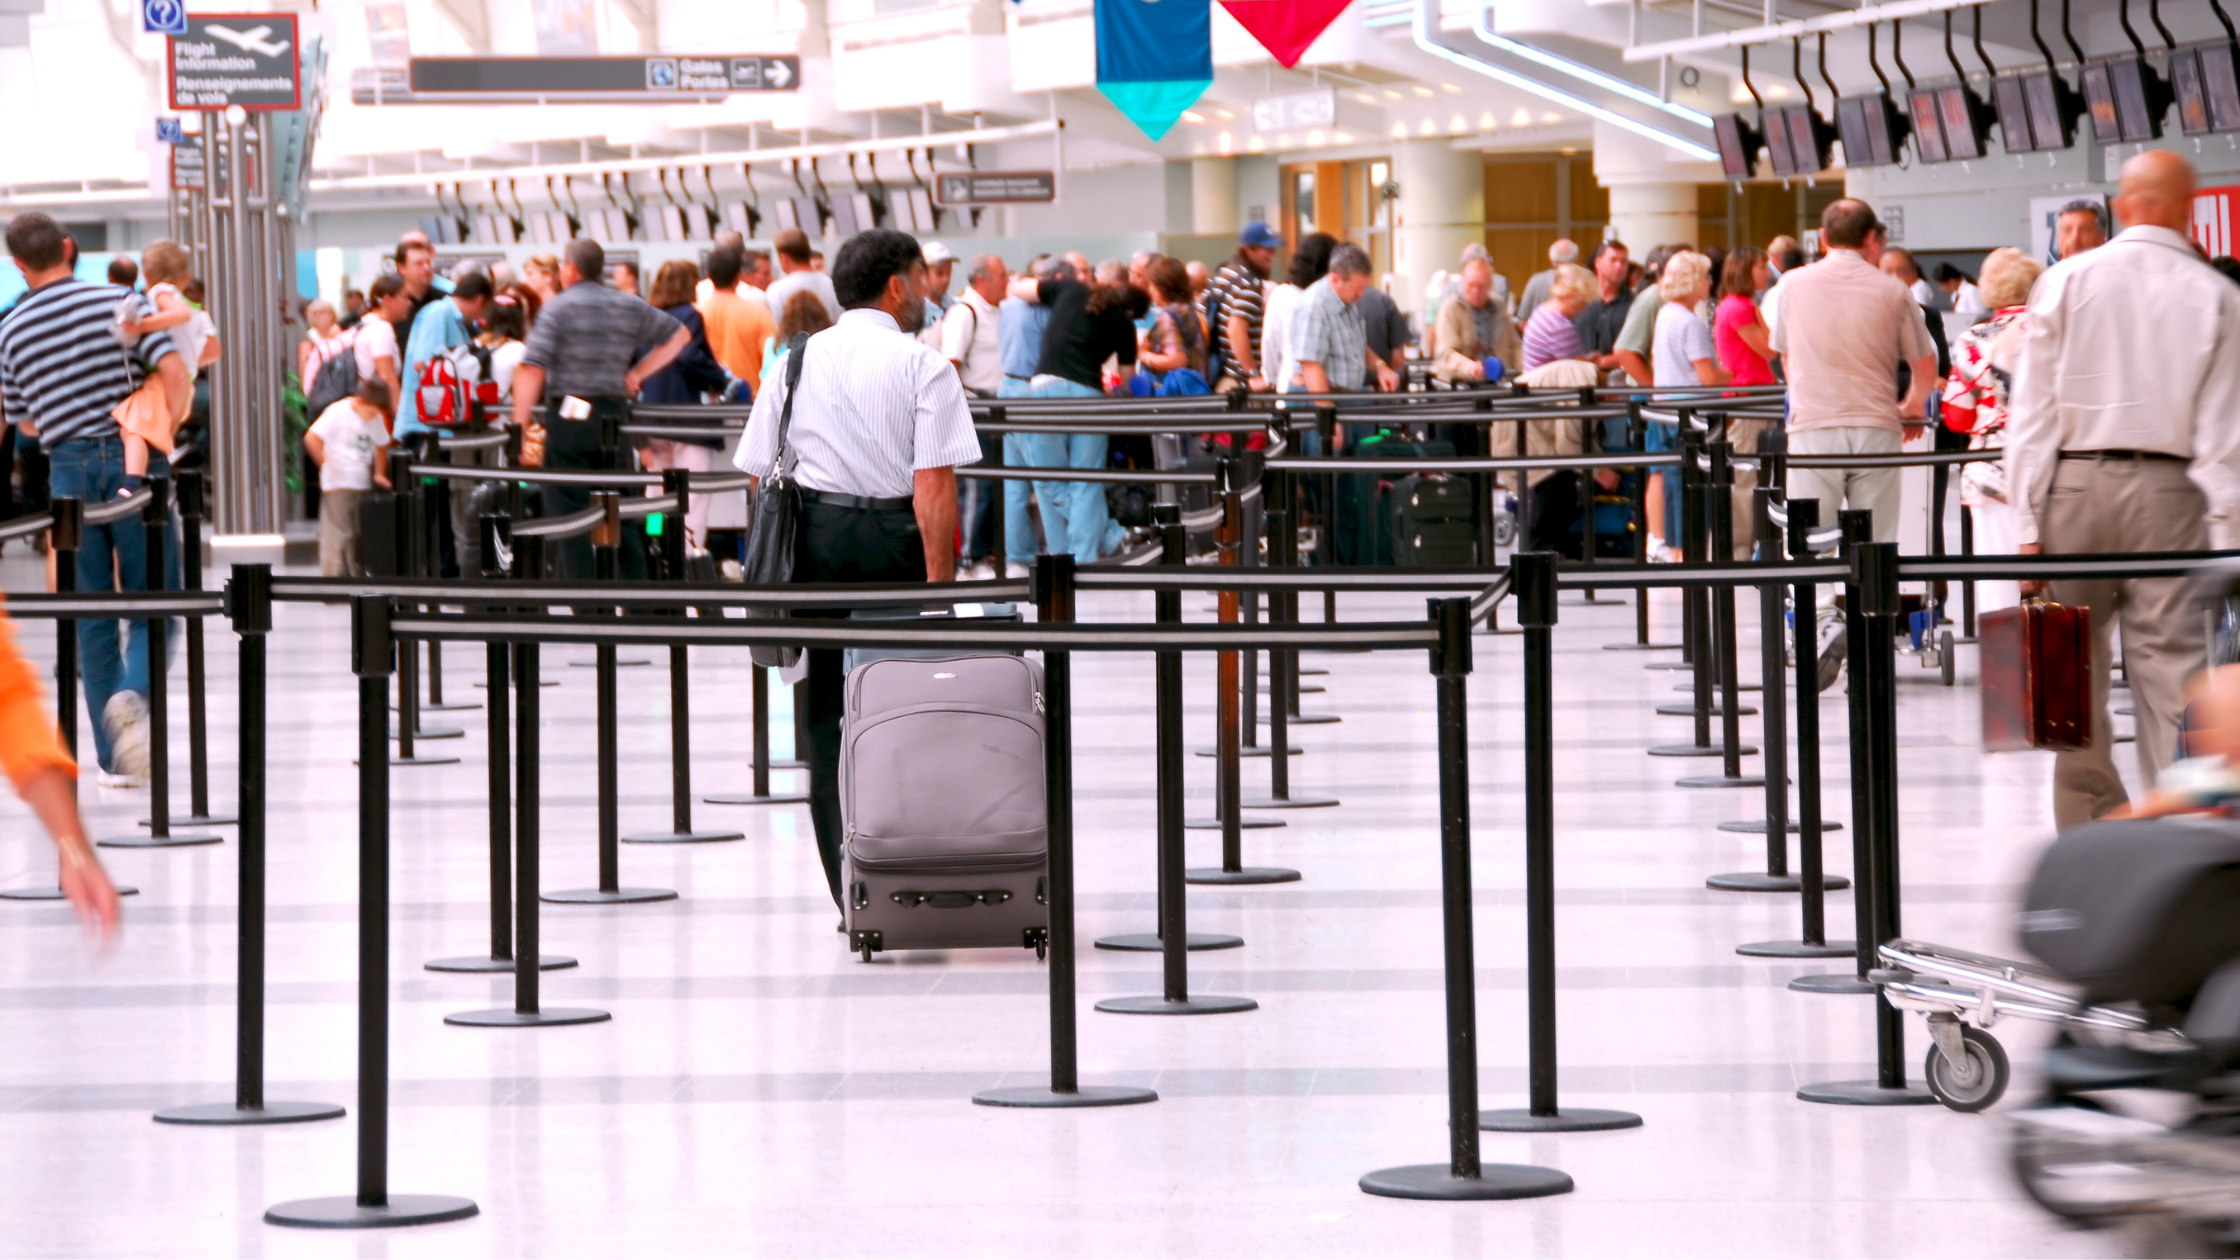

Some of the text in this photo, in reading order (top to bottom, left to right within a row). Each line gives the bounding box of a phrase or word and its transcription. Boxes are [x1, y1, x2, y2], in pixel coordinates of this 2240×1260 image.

[175, 41, 216, 58] Flight
[175, 56, 257, 70] Information
[680, 58, 724, 74] Gates
[175, 75, 293, 95] Renseignements
[681, 74, 730, 90] Portes
[176, 91, 228, 105] de vols
